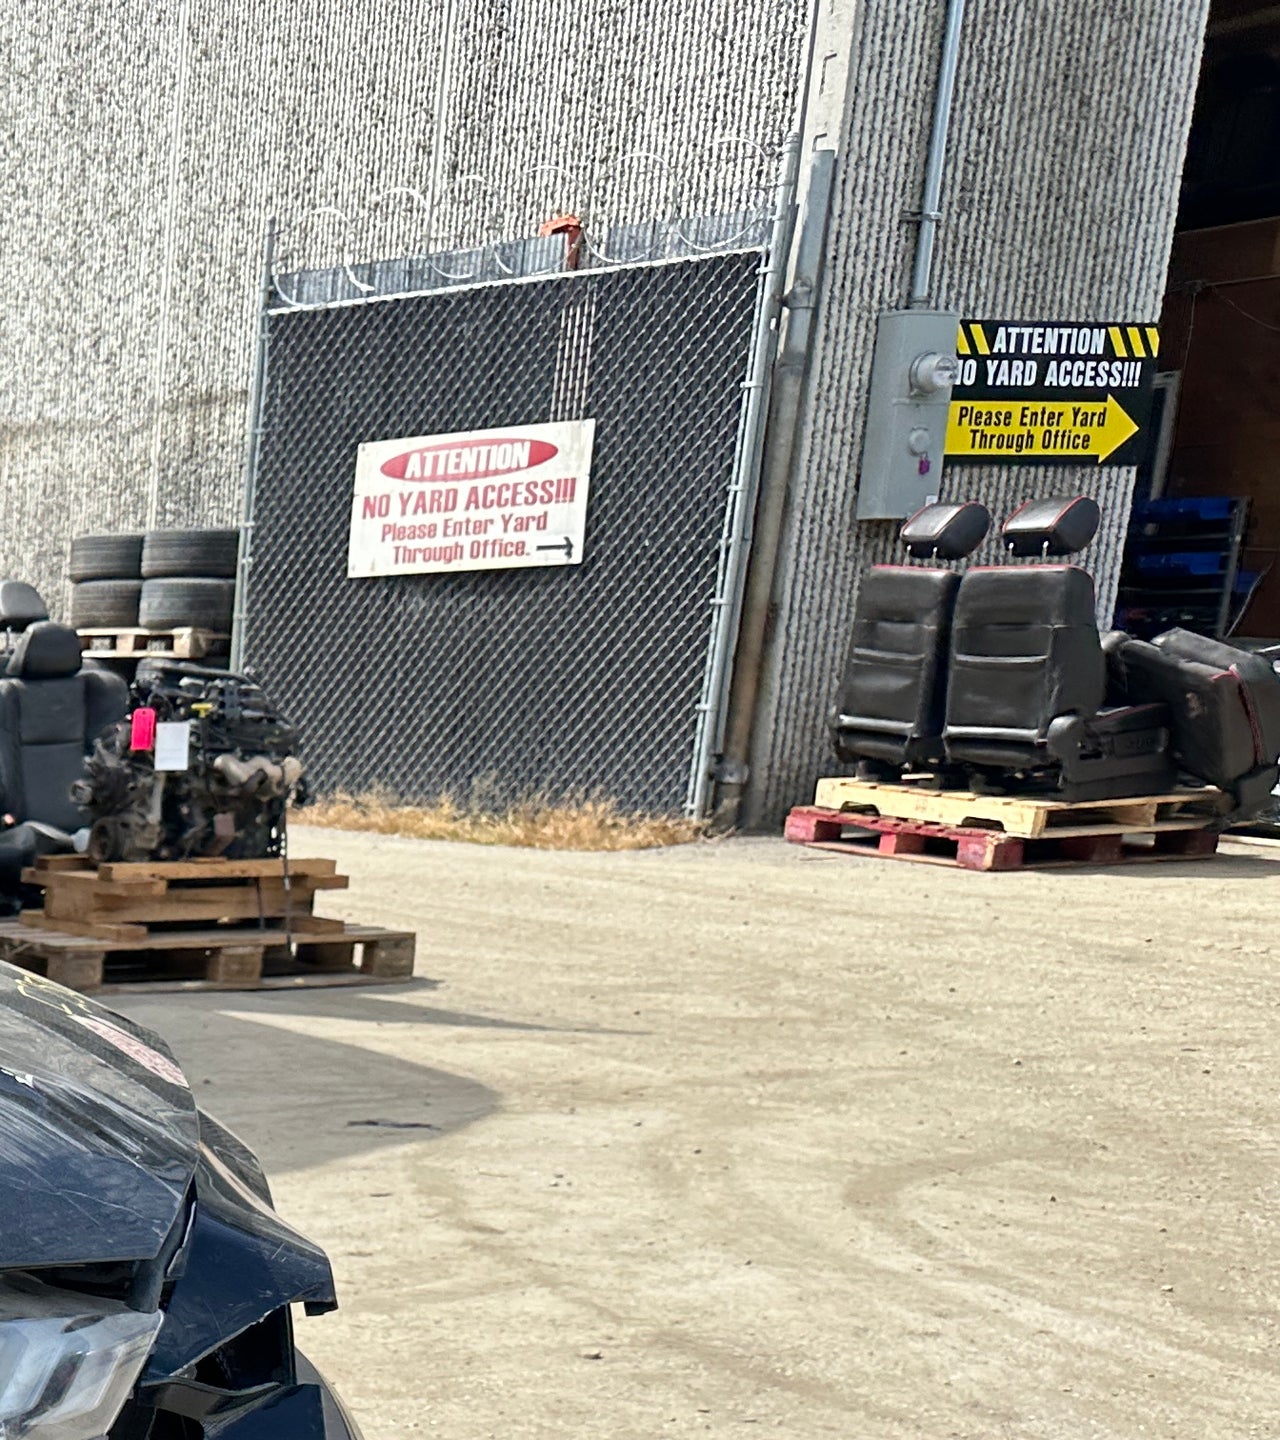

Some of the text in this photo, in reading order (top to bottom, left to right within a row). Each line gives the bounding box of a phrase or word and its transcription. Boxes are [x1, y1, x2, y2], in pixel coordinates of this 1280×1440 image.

[993, 327, 1106, 355] ATTENTION
[987, 360, 1037, 386] YARD
[1045, 361, 1142, 388] ACCESS!!!
[958, 406, 1107, 427] Please Enter Yard
[970, 430, 1091, 453] Through Office
[404, 441, 531, 479] ATTENTION
[362, 478, 577, 520] NO YARD ACCESS!!!
[381, 511, 548, 543] Please Enter Yard
[393, 543, 464, 565] Through
